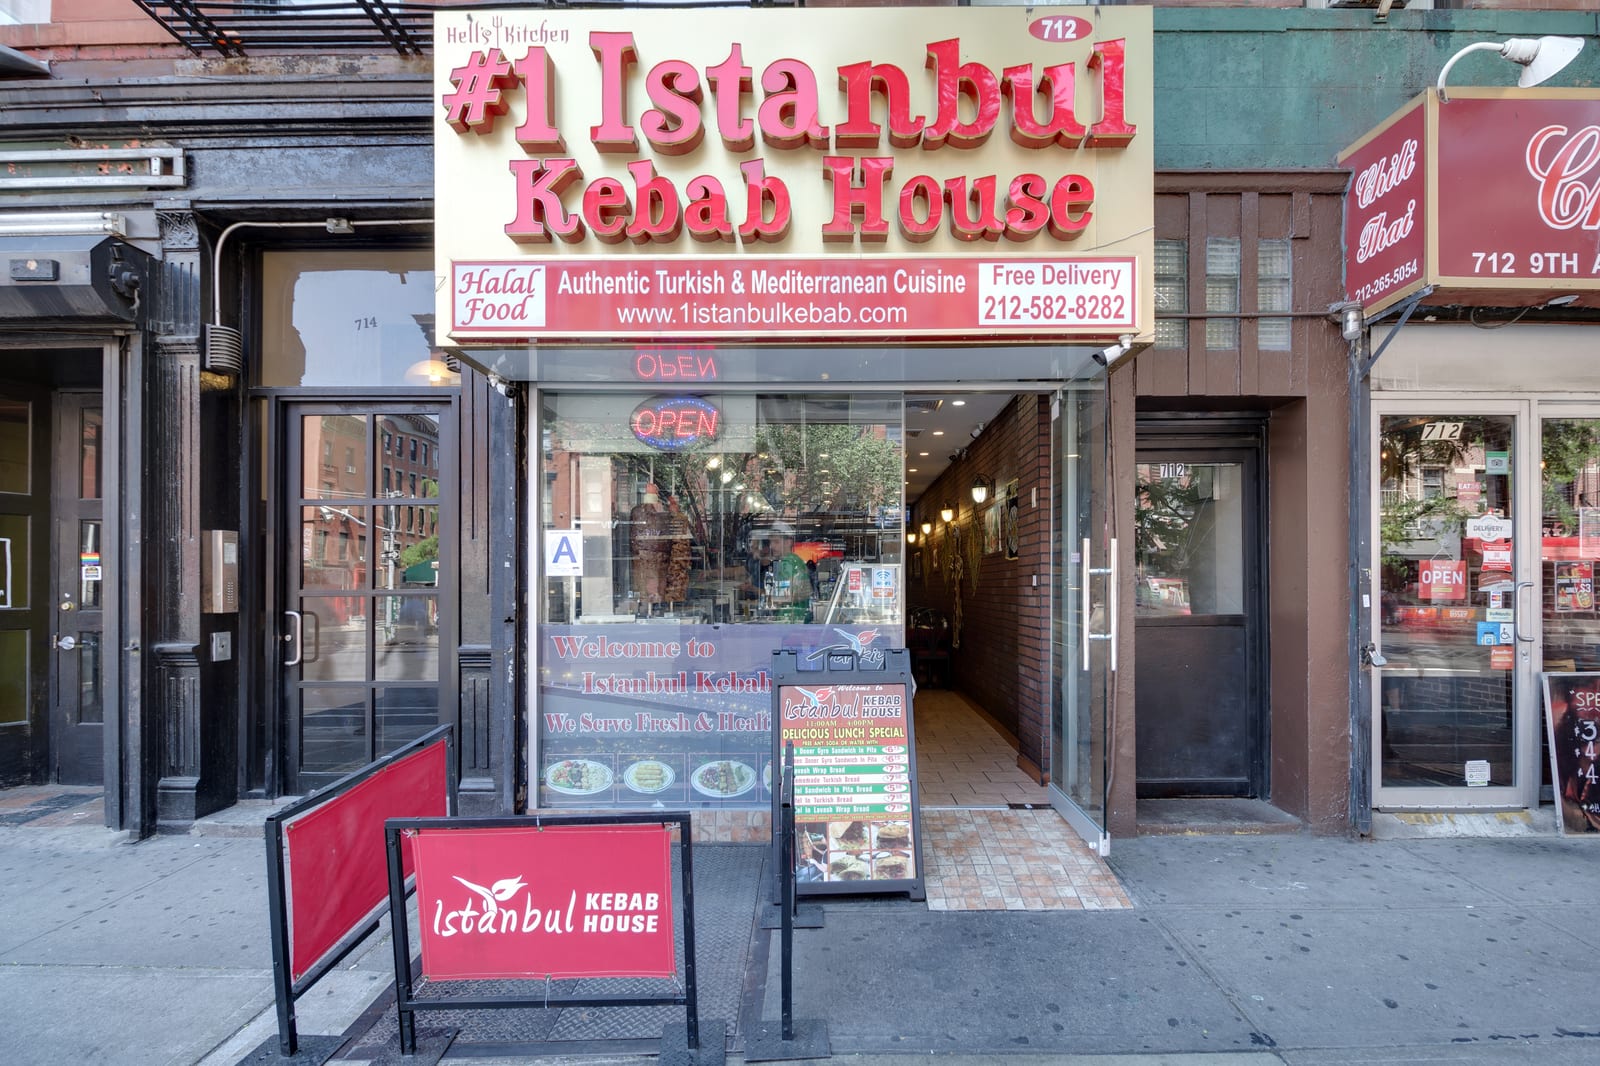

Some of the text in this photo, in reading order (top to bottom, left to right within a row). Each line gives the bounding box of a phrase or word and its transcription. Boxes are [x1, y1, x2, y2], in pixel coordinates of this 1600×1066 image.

[446, 19, 569, 45] Hell's Kitchen
[1041, 19, 1077, 40] 712
[442, 31, 1136, 153] #1 Istanbul
[1355, 139, 1418, 209] Chili
[504, 156, 1096, 243] Kebab House
[1356, 199, 1416, 264] Thai
[1471, 252, 1515, 274] 712
[1529, 252, 1579, 274] 9TH
[458, 267, 541, 295] Halal
[558, 269, 967, 295] Authentic Turkish & Mediterranean Cuisine
[992, 264, 1121, 290] Free Delivery
[1355, 258, 1418, 302] 212-265-5054
[460, 295, 535, 325] Food
[617, 302, 908, 324] www.1istanbulkebab.com
[984, 295, 1126, 320] 212-582-8282
[354, 316, 378, 331] 714
[635, 410, 718, 437] OPEN
[1426, 423, 1461, 439] 712
[1160, 464, 1184, 477] 712
[552, 535, 577, 563] A
[1421, 570, 1464, 585] OPEN
[551, 636, 716, 659] Welcome to
[582, 671, 772, 694] Istanbul Kebab
[784, 693, 860, 721] Istanbul
[861, 706, 902, 718] HOUSE
[862, 695, 902, 706] KEBAB
[545, 712, 577, 733] We
[580, 712, 632, 733] Serve
[635, 712, 691, 732] Fresh
[694, 712, 714, 732] &
[783, 727, 905, 740] DELICIOUS LUNCH SPECIAL
[831, 746, 857, 754] Sandwich
[835, 756, 858, 764] Sandwich
[794, 767, 811, 775] avash
[433, 889, 577, 937] Istanbul
[585, 893, 659, 911] KEBAB
[583, 915, 658, 933] HOUSE
